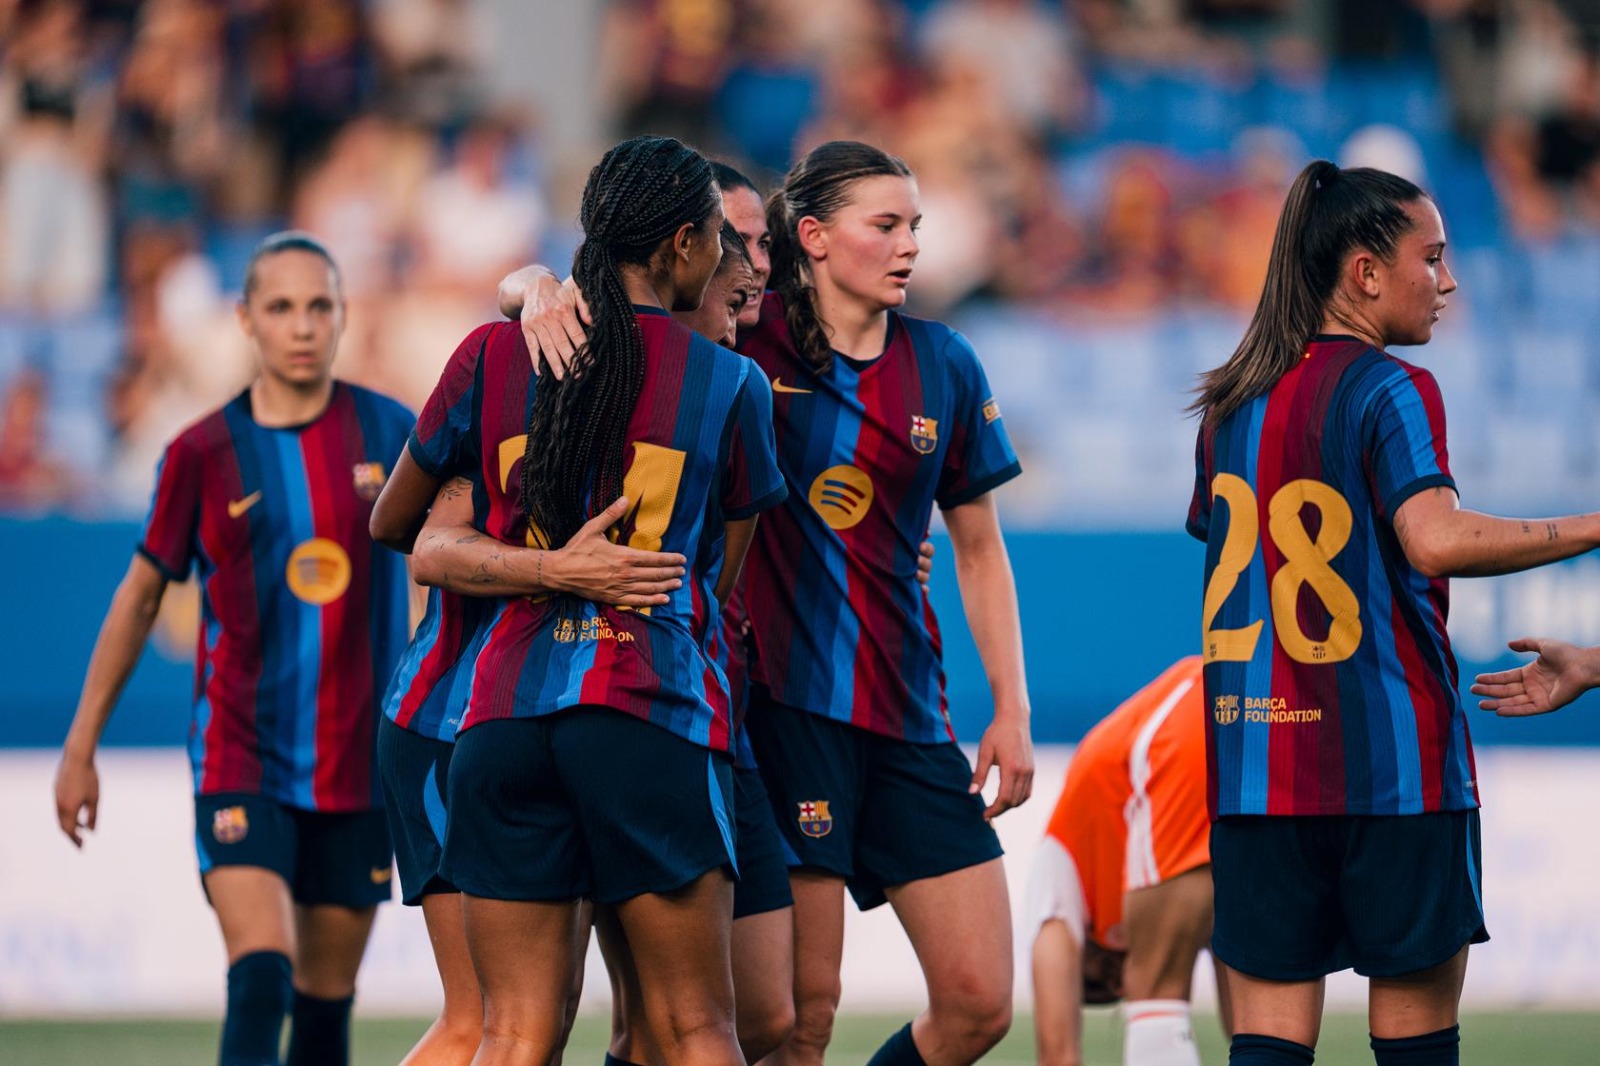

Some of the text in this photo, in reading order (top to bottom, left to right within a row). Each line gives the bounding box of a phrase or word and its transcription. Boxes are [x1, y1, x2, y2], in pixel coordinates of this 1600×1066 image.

[1202, 472, 1363, 665] 28
[1244, 697, 1287, 711] BARÇA
[1244, 709, 1322, 723] FOUNDATION
